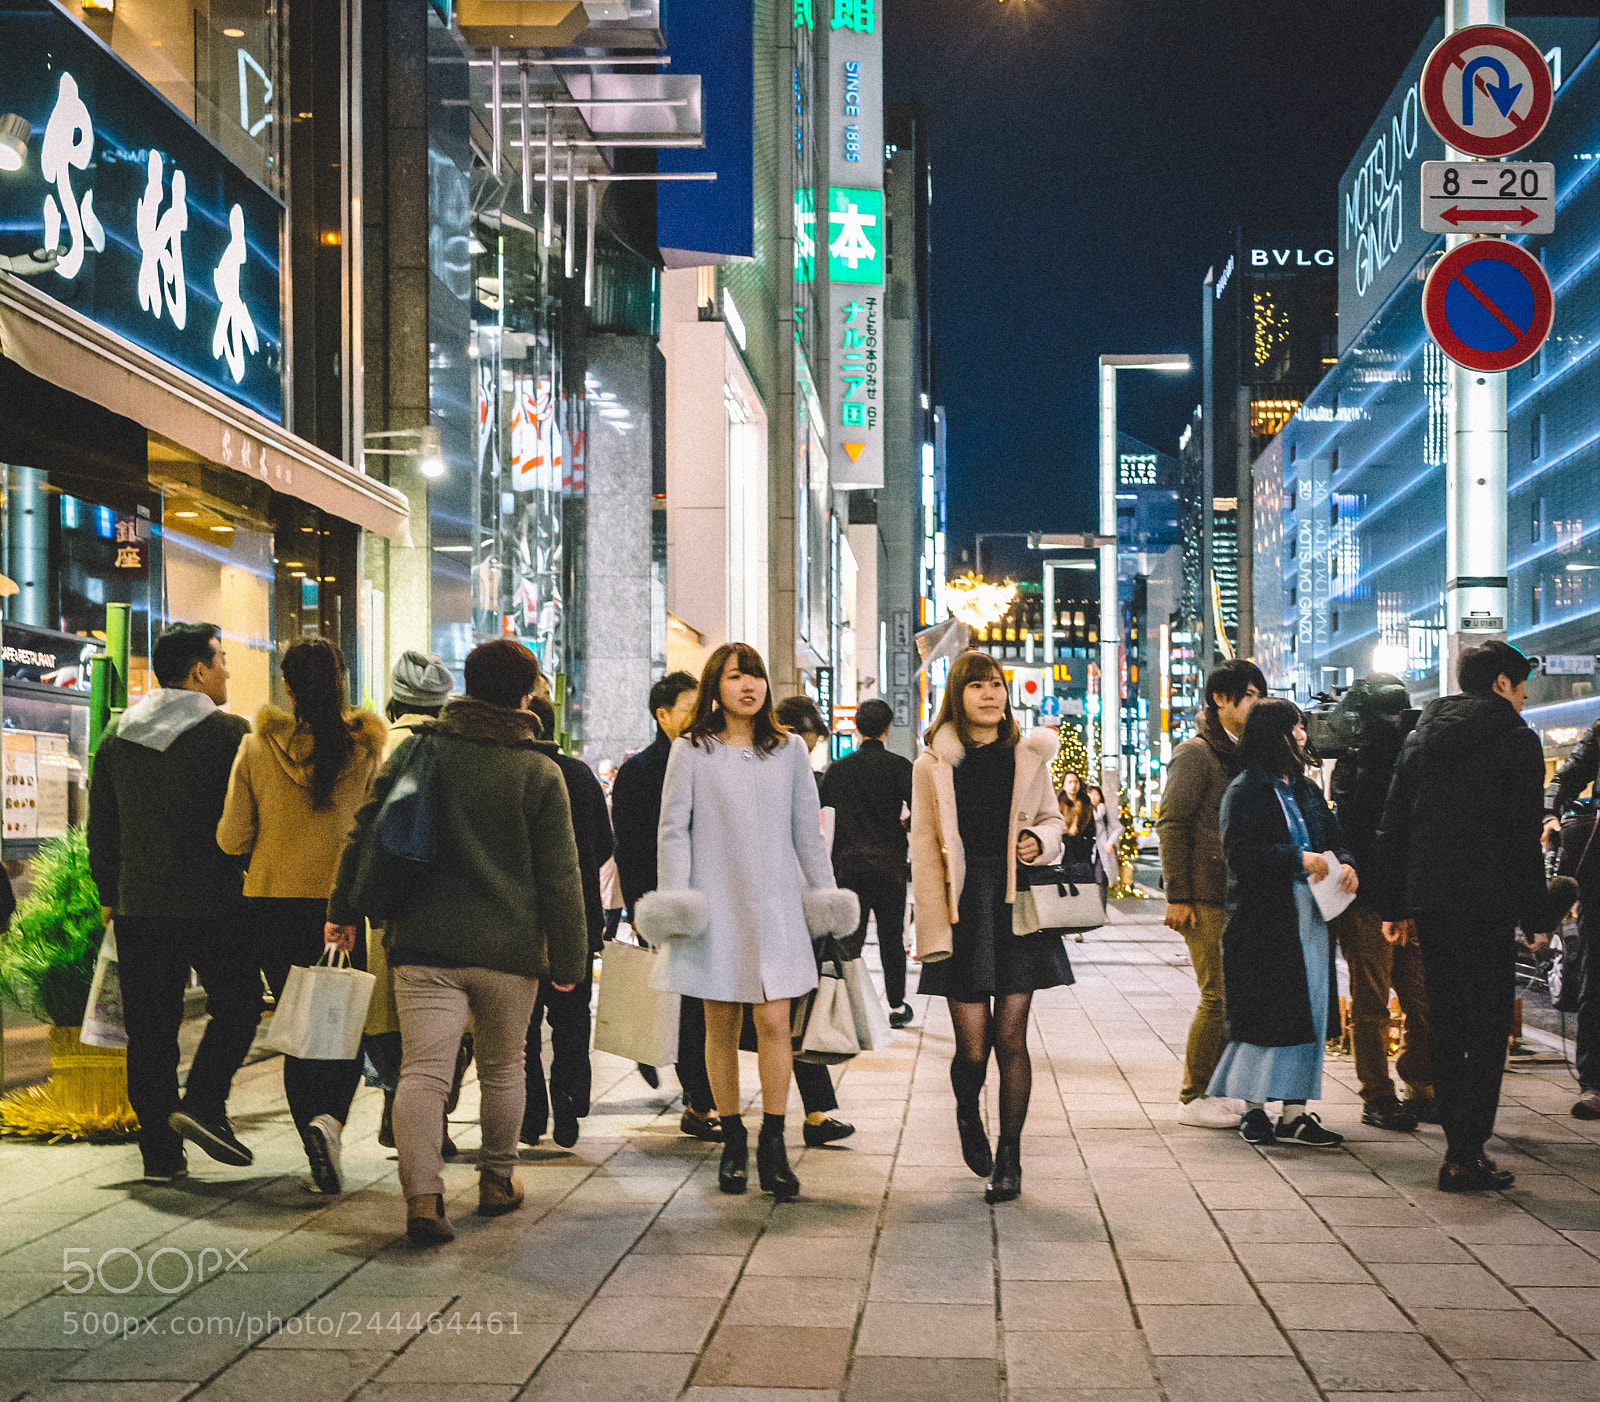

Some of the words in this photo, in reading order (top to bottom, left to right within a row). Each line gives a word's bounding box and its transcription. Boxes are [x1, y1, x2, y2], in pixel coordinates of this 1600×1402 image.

[845, 60, 861, 117] SINCE
[845, 123, 861, 162] 1885
[829, 203, 877, 269] 本
[841, 300, 867, 427] ナルニア国
[1299, 520, 1312, 592] MATSUYA
[1299, 596, 1312, 643] GINZA
